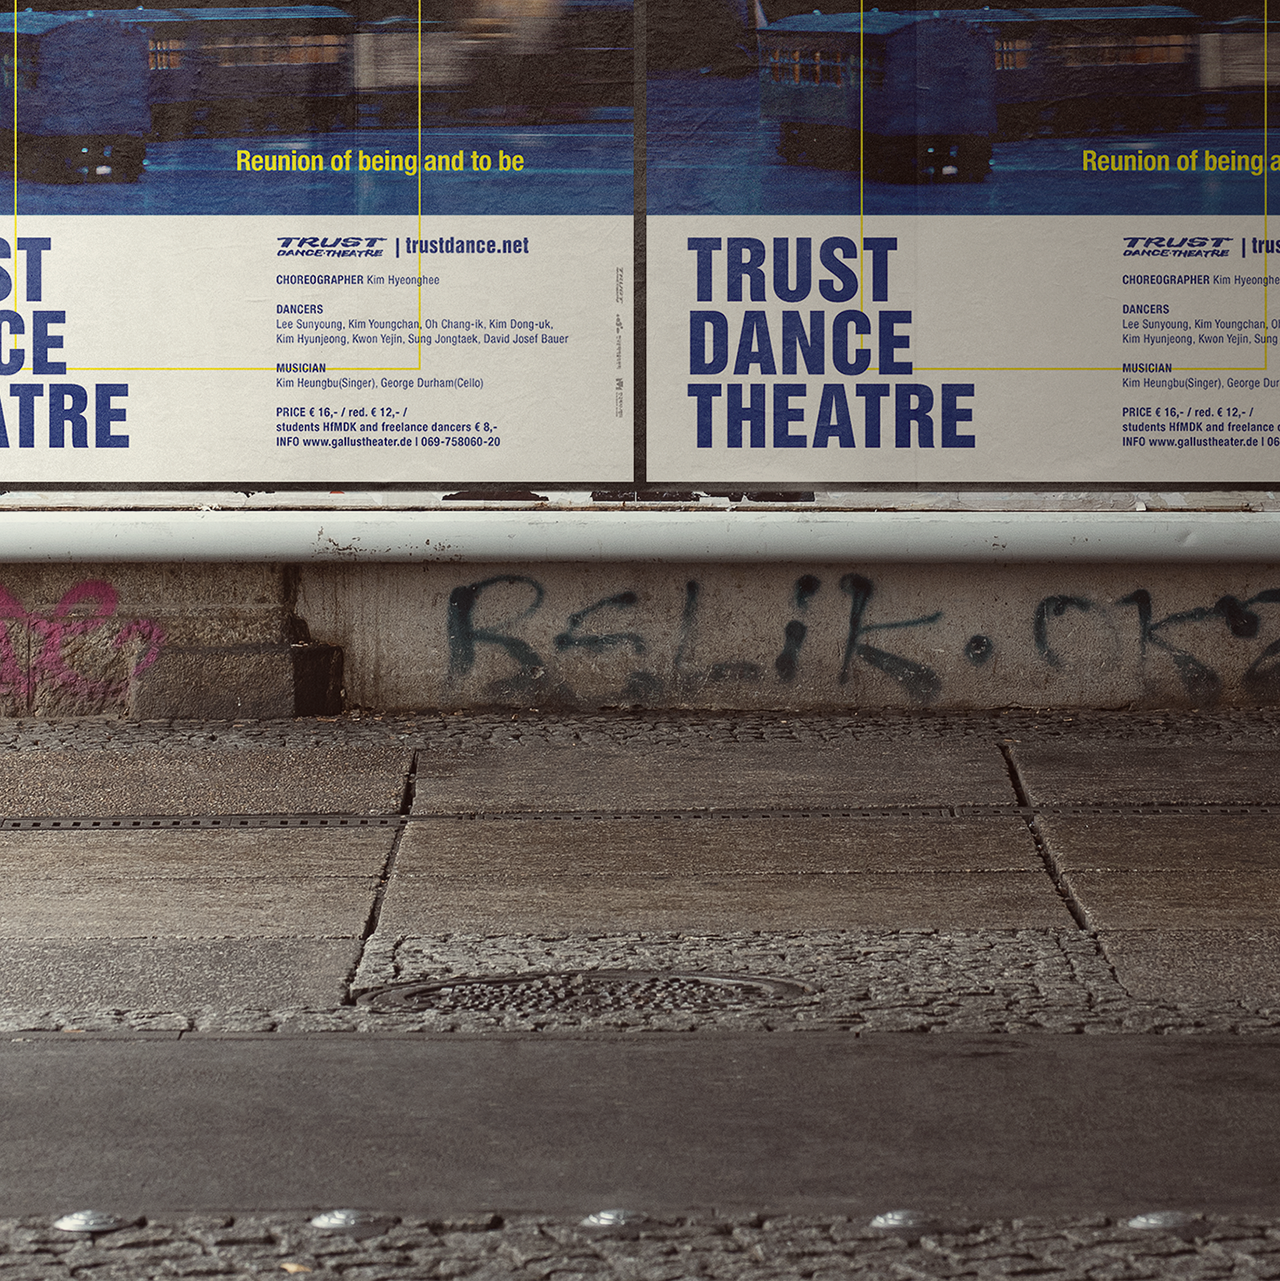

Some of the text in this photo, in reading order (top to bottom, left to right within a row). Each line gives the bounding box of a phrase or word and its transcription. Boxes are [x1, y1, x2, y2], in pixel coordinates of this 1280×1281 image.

[237, 150, 524, 176] Reunion of being and to be
[1083, 150, 1171, 172] Reunion
[1177, 150, 1197, 172] of
[1204, 150, 1264, 176] being
[277, 237, 387, 248] TRUST
[406, 237, 529, 254] trustdance.net
[1123, 237, 1233, 248] TRUST
[688, 237, 897, 302] TRUST
[277, 275, 440, 288] CHOREOGRAPHER Kim Hyeonghee
[277, 304, 323, 314] DANCERS
[277, 319, 553, 332] Lee Sunyoung, Kim Youngchan, Oh Chang-ik, Kim Dong-uk,
[277, 334, 569, 347] Kim Hyunjeong, Kwon Yejin, Sung Jongtaek, David Josef Bauer
[690, 310, 912, 375] DANCE
[277, 363, 326, 374] MUSICIAN
[277, 378, 294, 388] Kim
[381, 378, 414, 390] George
[418, 378, 483, 390] Durham(Cello)
[277, 407, 400, 419] PRICE 16,- red. 12,-
[688, 384, 975, 449] THEATRE
[276, 422, 498, 434] students HfMDK and freelance dancers 8,-
[277, 437, 500, 449] INFO www.gallustheater.de 069-758060-20
[1123, 437, 1145, 447] INFO
[1149, 437, 1258, 449] www.gallustheater.de
